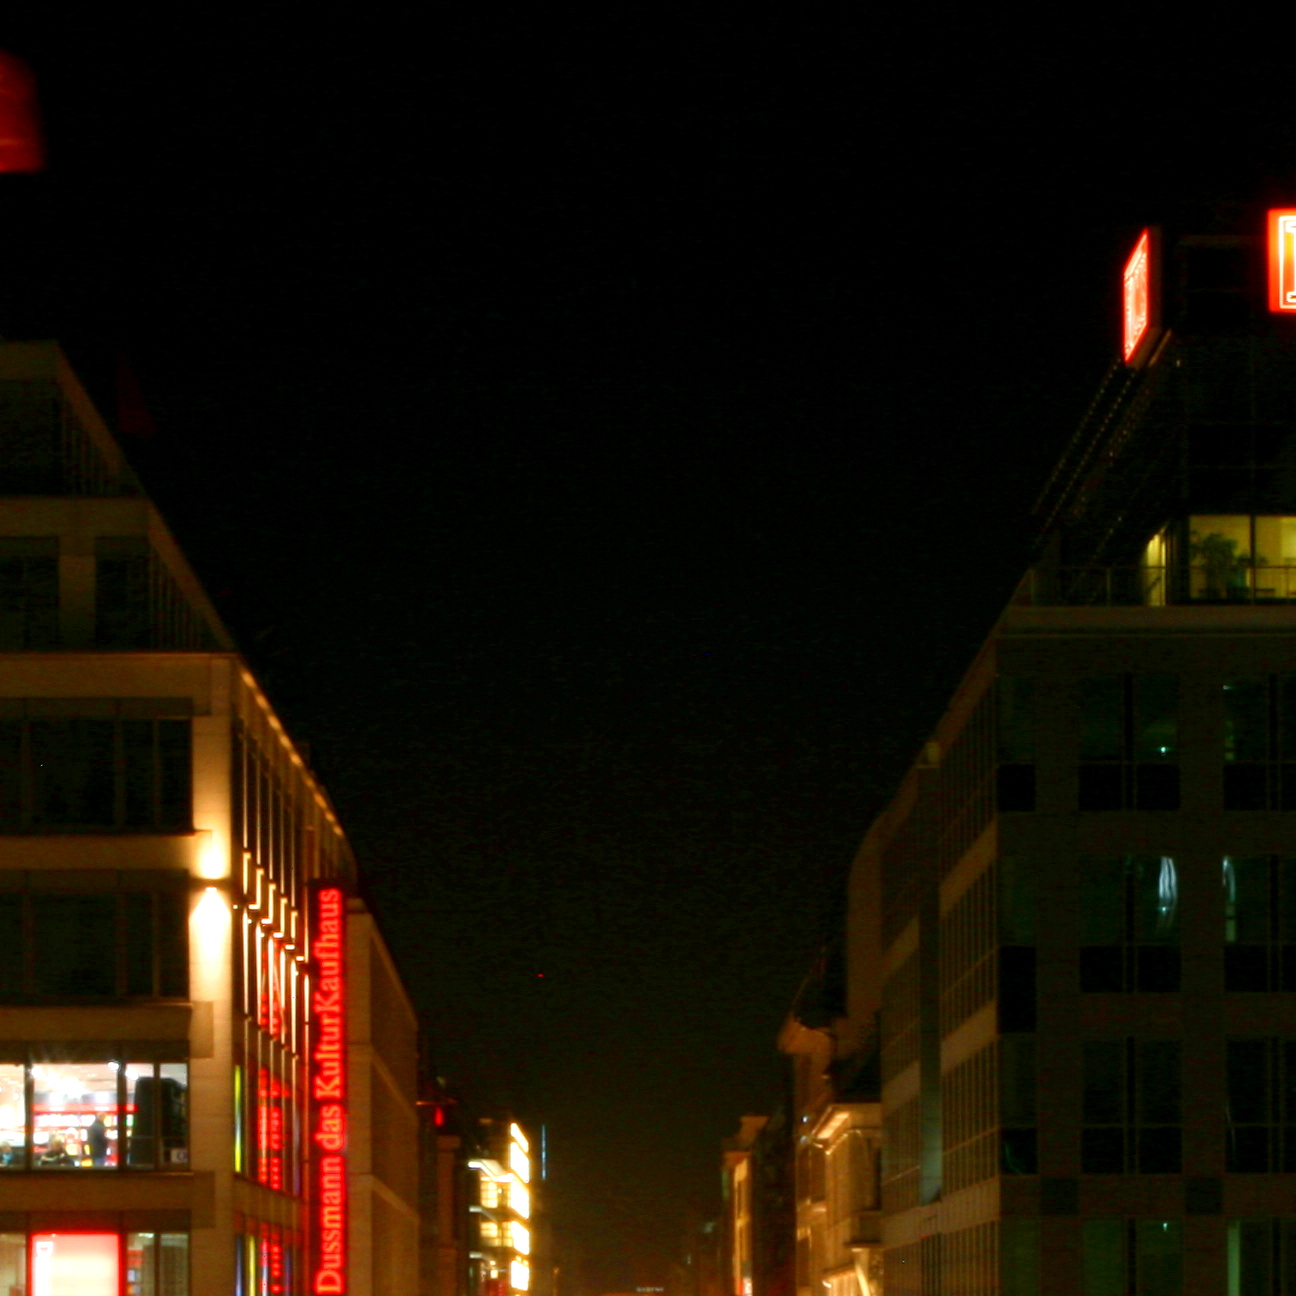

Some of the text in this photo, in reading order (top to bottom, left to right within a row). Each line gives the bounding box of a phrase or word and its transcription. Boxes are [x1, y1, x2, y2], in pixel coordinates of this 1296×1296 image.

[314, 887, 345, 1295] Dussmann das KulturKaufhaus
